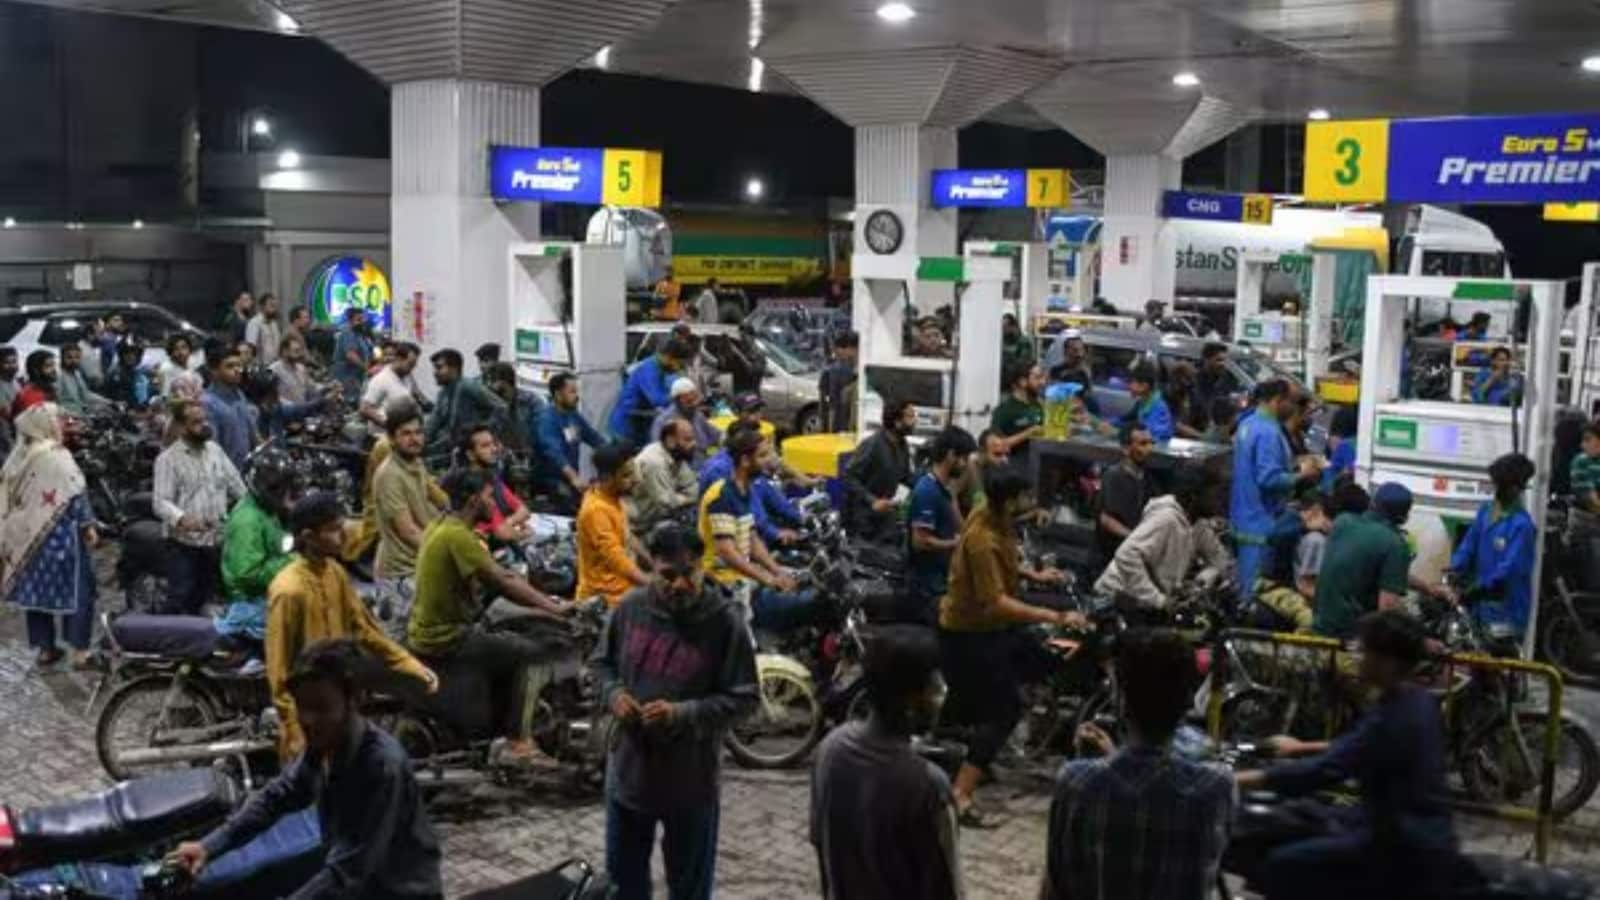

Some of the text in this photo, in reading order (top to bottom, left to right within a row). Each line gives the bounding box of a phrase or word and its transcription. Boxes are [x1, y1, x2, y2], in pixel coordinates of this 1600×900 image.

[1502, 135, 1559, 153] Euro
[1562, 128, 1589, 152] 5
[1334, 138, 1361, 186] 3
[1438, 155, 1600, 184] Premier
[511, 170, 580, 191] Premier
[618, 160, 631, 192] 5
[1037, 177, 1049, 198] 7
[1186, 198, 1221, 213] CNG
[1247, 200, 1263, 218] 15
